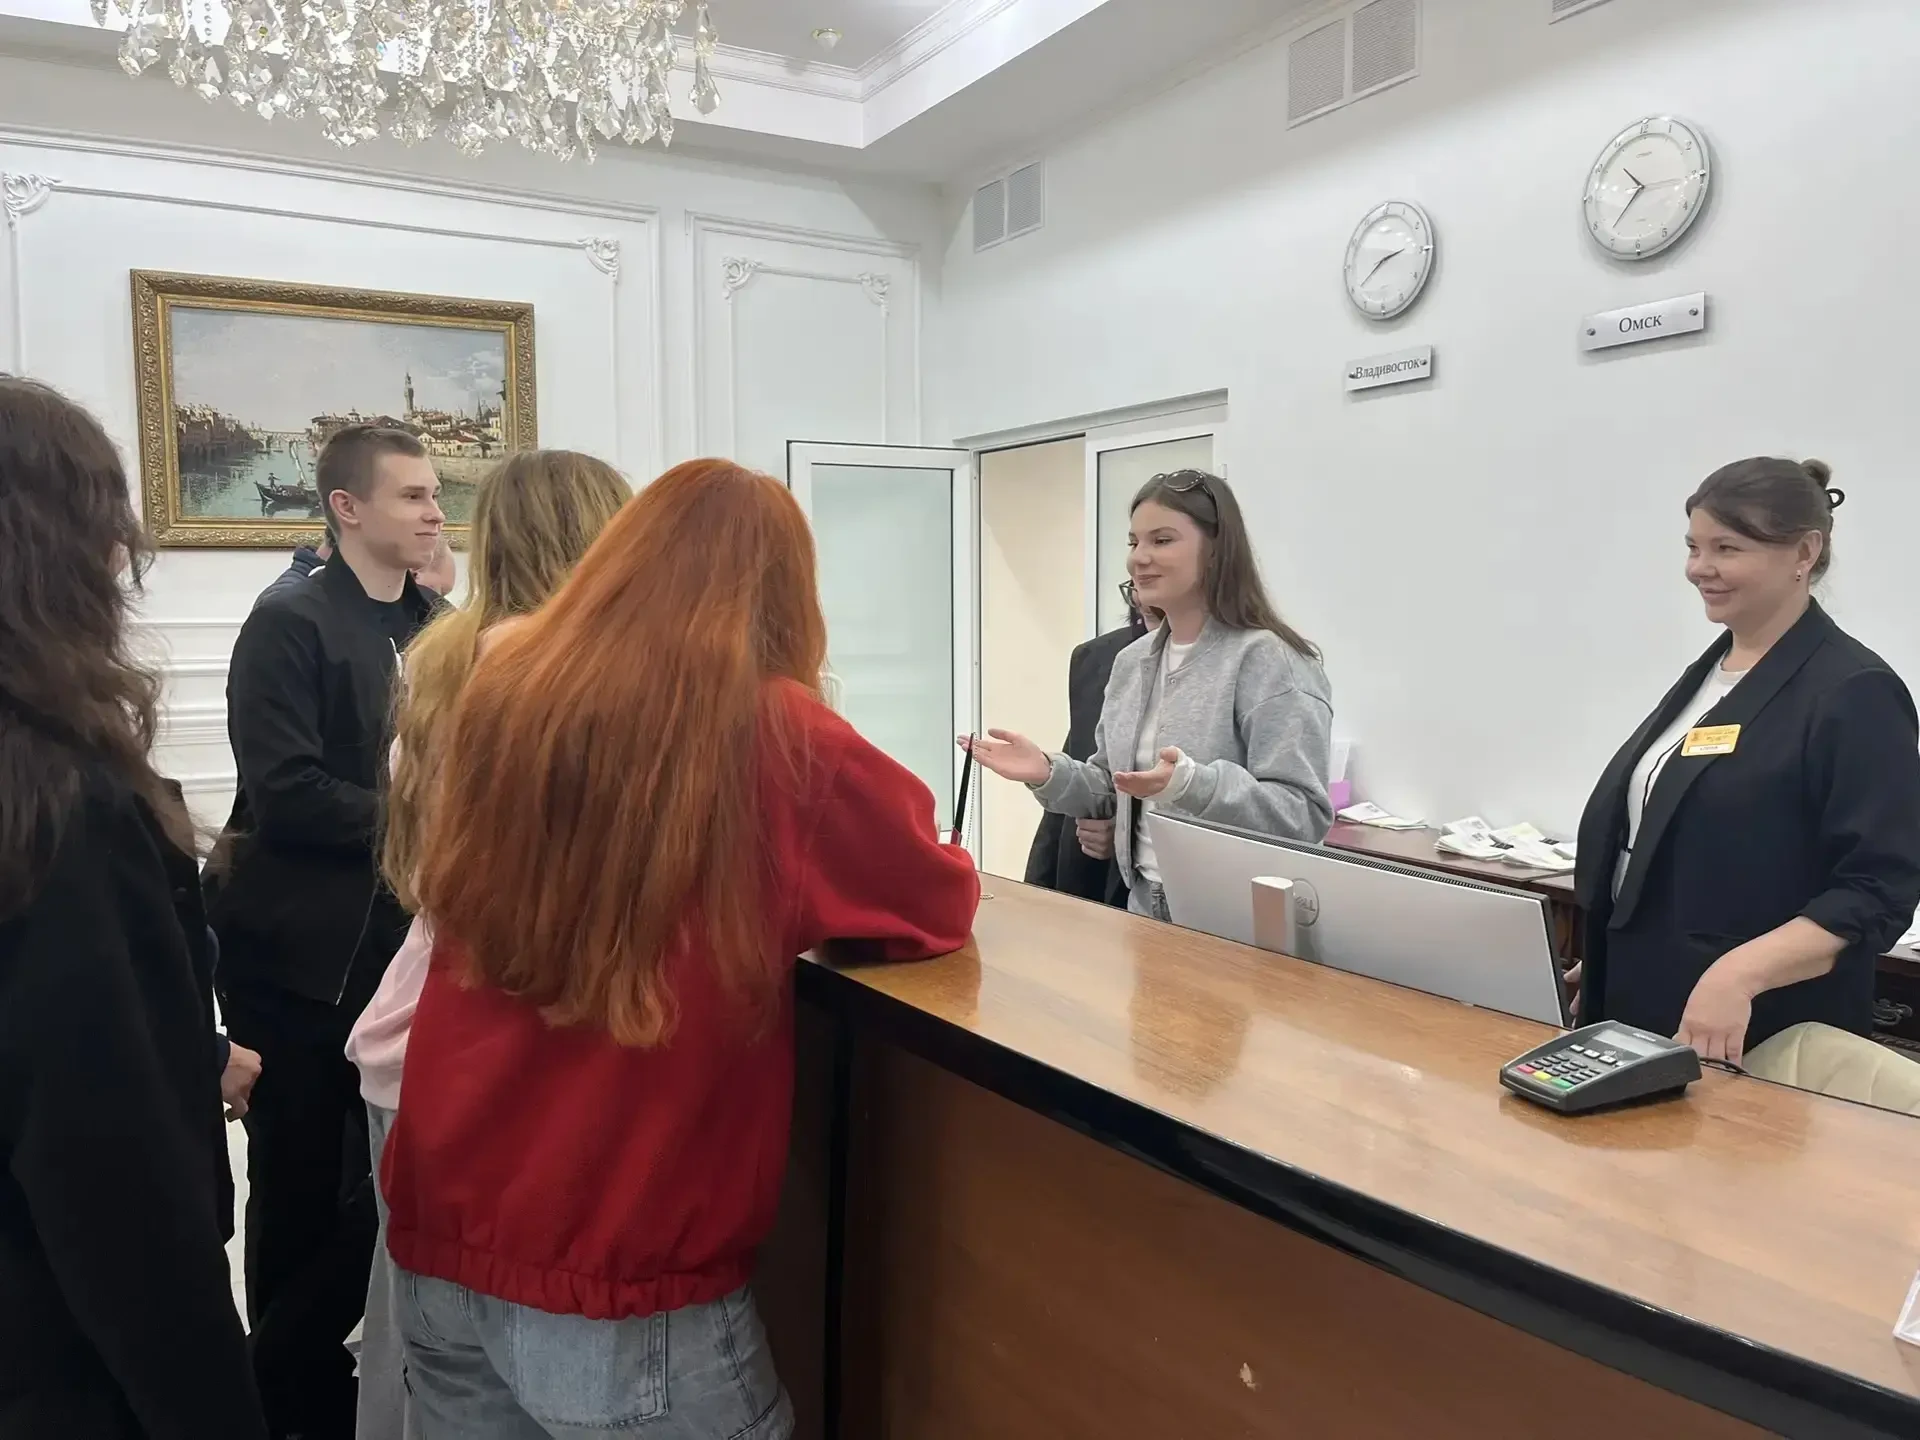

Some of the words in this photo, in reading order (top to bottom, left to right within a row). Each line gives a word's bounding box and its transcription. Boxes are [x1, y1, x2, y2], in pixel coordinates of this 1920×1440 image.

[1639, 124, 1649, 134] 12
[1685, 140, 1692, 150] 2
[1661, 227, 1668, 237] 5
[1610, 238, 1615, 248] 7
[1635, 239, 1641, 249] 6
[1618, 314, 1663, 334] Омск
[1355, 358, 1421, 380] Владивосток
